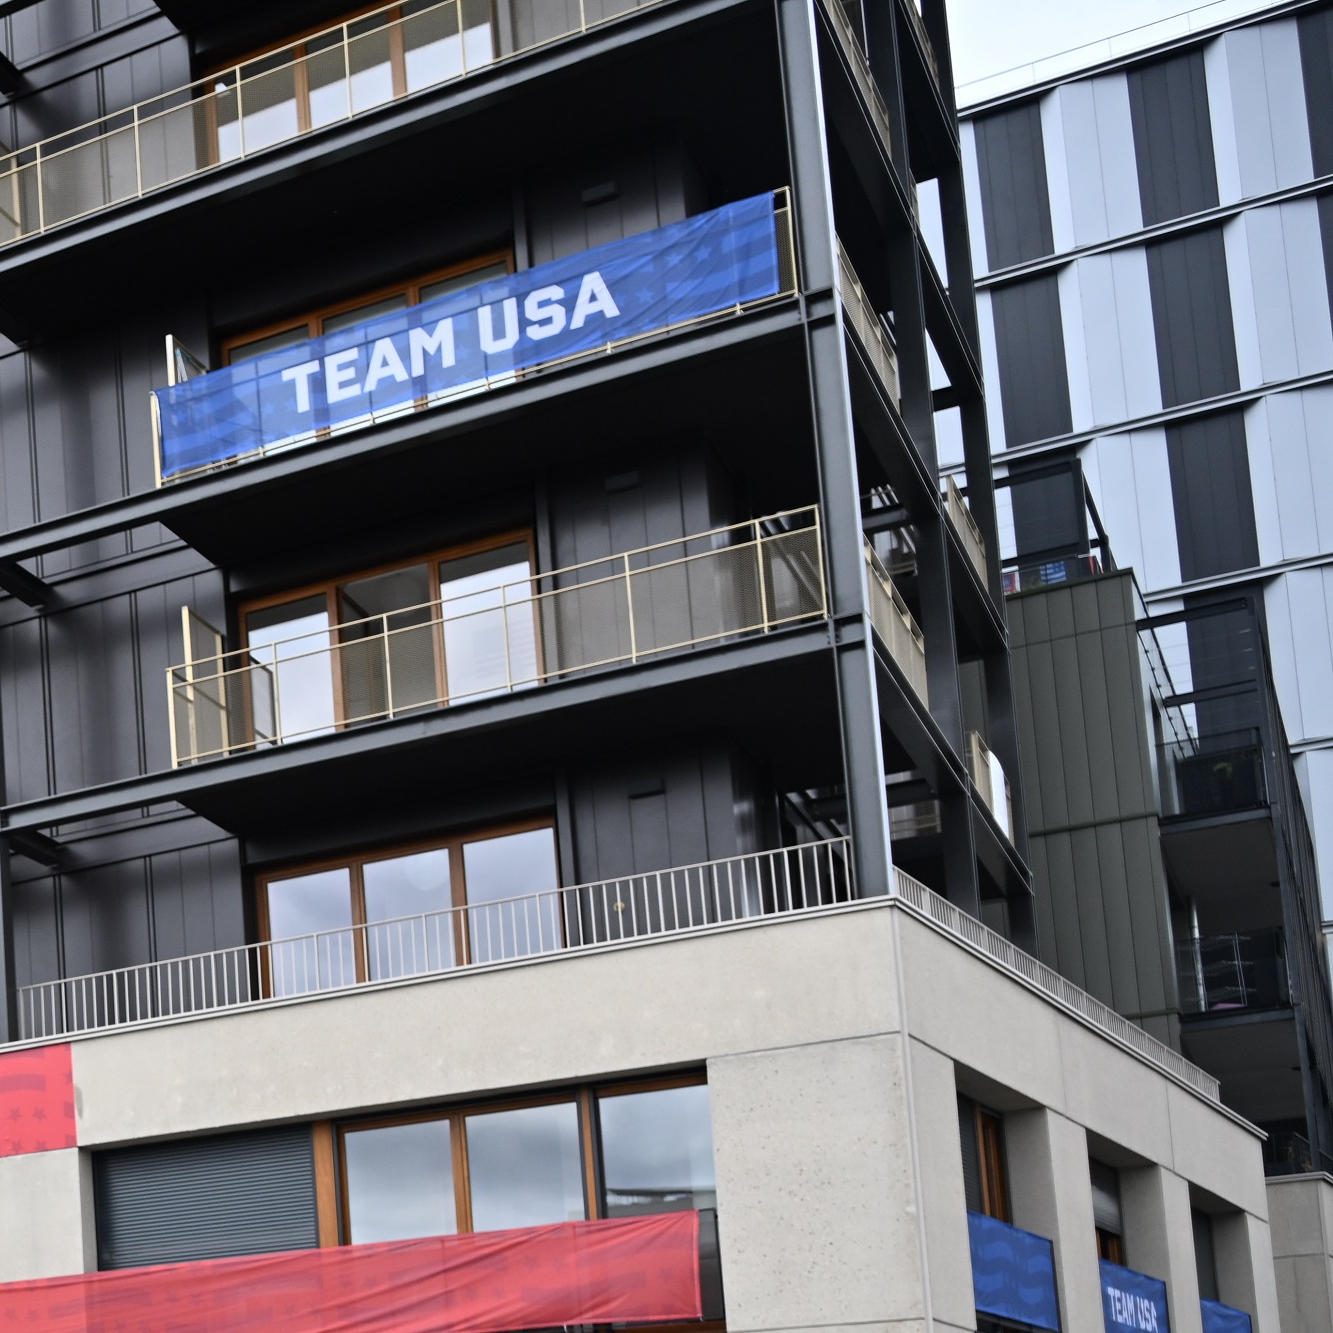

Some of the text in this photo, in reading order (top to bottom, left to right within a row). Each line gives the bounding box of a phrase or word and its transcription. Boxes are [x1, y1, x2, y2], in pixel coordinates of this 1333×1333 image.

[281, 271, 621, 414] TEAM USA
[1107, 1286, 1136, 1328] TEAM
